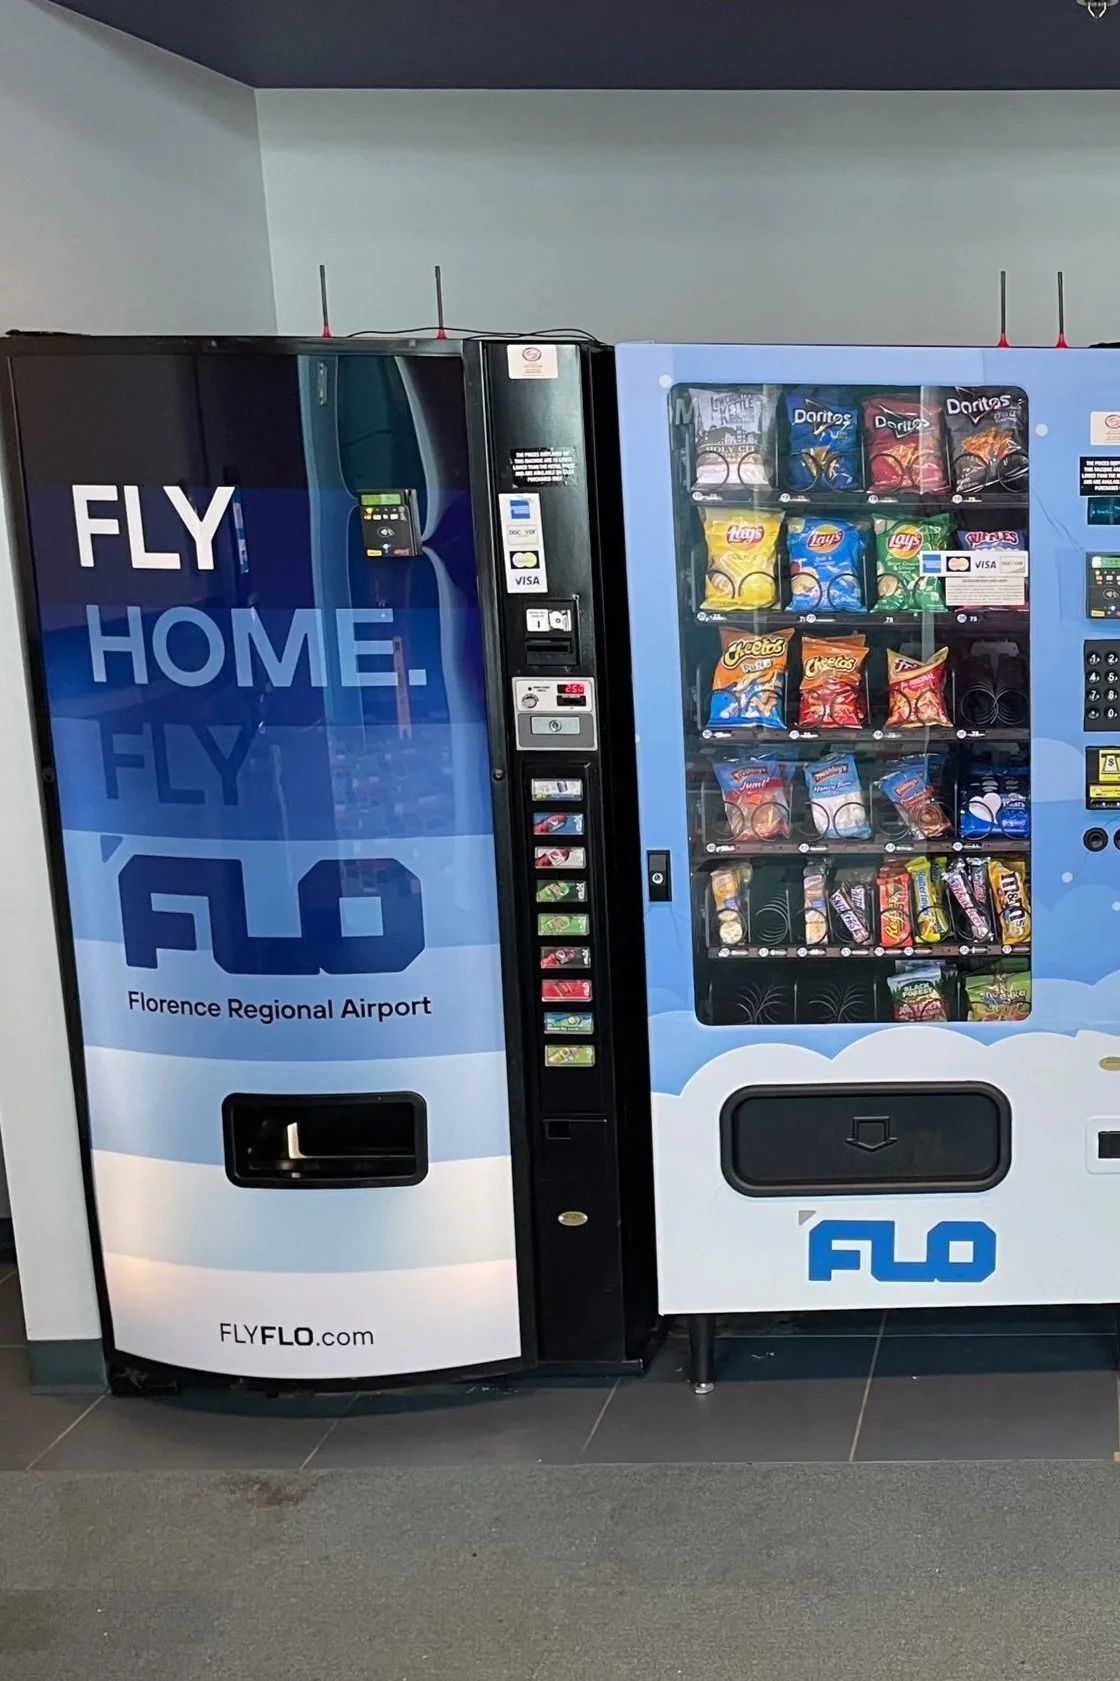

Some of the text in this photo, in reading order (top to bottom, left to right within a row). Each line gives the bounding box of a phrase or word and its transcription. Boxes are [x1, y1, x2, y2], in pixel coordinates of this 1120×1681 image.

[946, 394, 1011, 415] Doritos
[794, 409, 851, 425] Doritos
[874, 415, 931, 433] Doritos
[71, 484, 235, 570] FLY
[809, 530, 843, 547] Lay's
[975, 560, 997, 569] VISA
[515, 576, 540, 586] VISA
[85, 604, 428, 688] HOME.
[724, 637, 784, 667] Cheetos
[1091, 654, 1096, 663] 1
[1108, 654, 1115, 663] 2
[805, 656, 857, 678] Cheetos
[1089, 672, 1096, 682] 4
[1108, 672, 1115, 682] 5
[1090, 690, 1097, 700] 7
[1108, 690, 1115, 700] 8
[1108, 709, 1114, 718] 0
[102, 719, 254, 806] FLY
[118, 854, 426, 976] FLO
[903, 987, 933, 997] FOREST
[904, 983, 930, 992] BLACK
[128, 990, 432, 1025] Florence Regional Airport
[808, 1219, 997, 1283] FLO
[220, 1322, 374, 1347] FLYFLO.com
